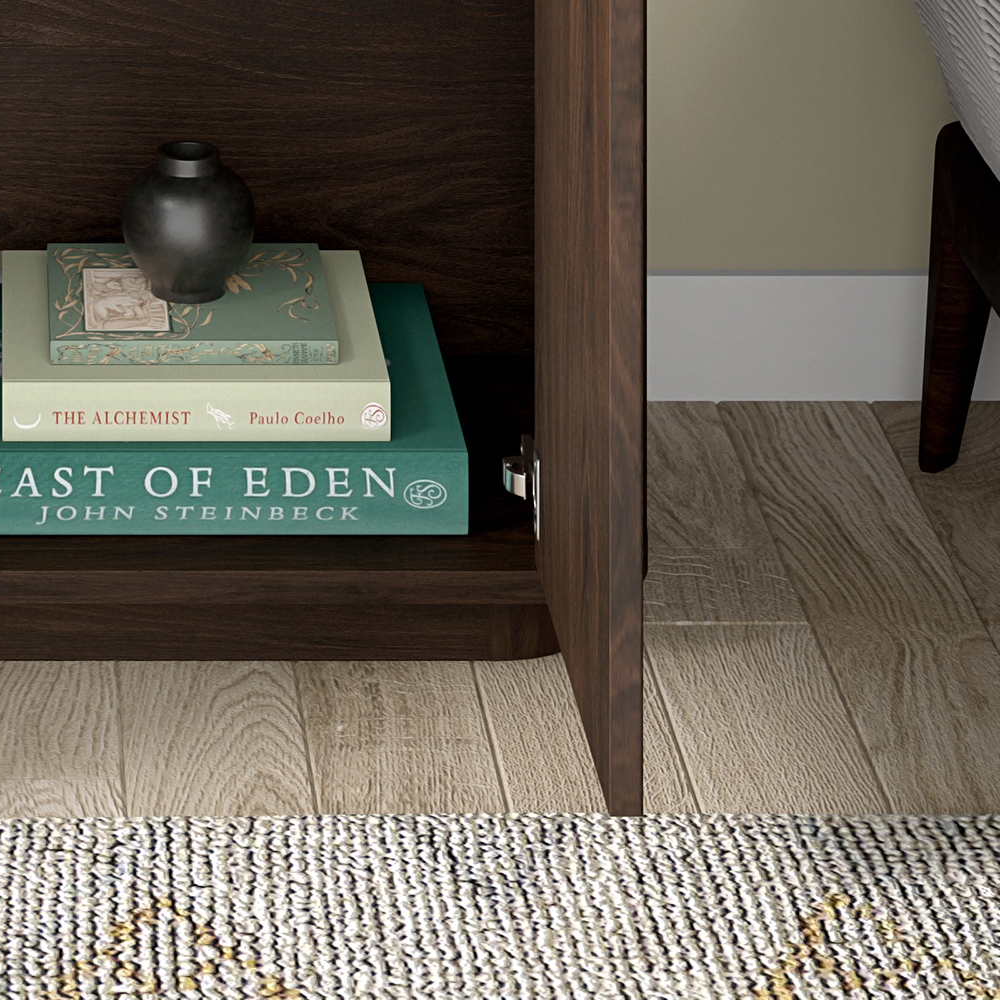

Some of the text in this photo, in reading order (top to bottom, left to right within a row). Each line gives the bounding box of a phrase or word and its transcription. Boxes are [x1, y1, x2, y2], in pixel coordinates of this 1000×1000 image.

[52, 410, 191, 426] THE ALCHEMIST
[249, 410, 345, 426] Paulo Coelho
[144, 466, 213, 498] OF
[243, 466, 397, 498] EDEN
[35, 505, 360, 525] JOHN STEINBECK
